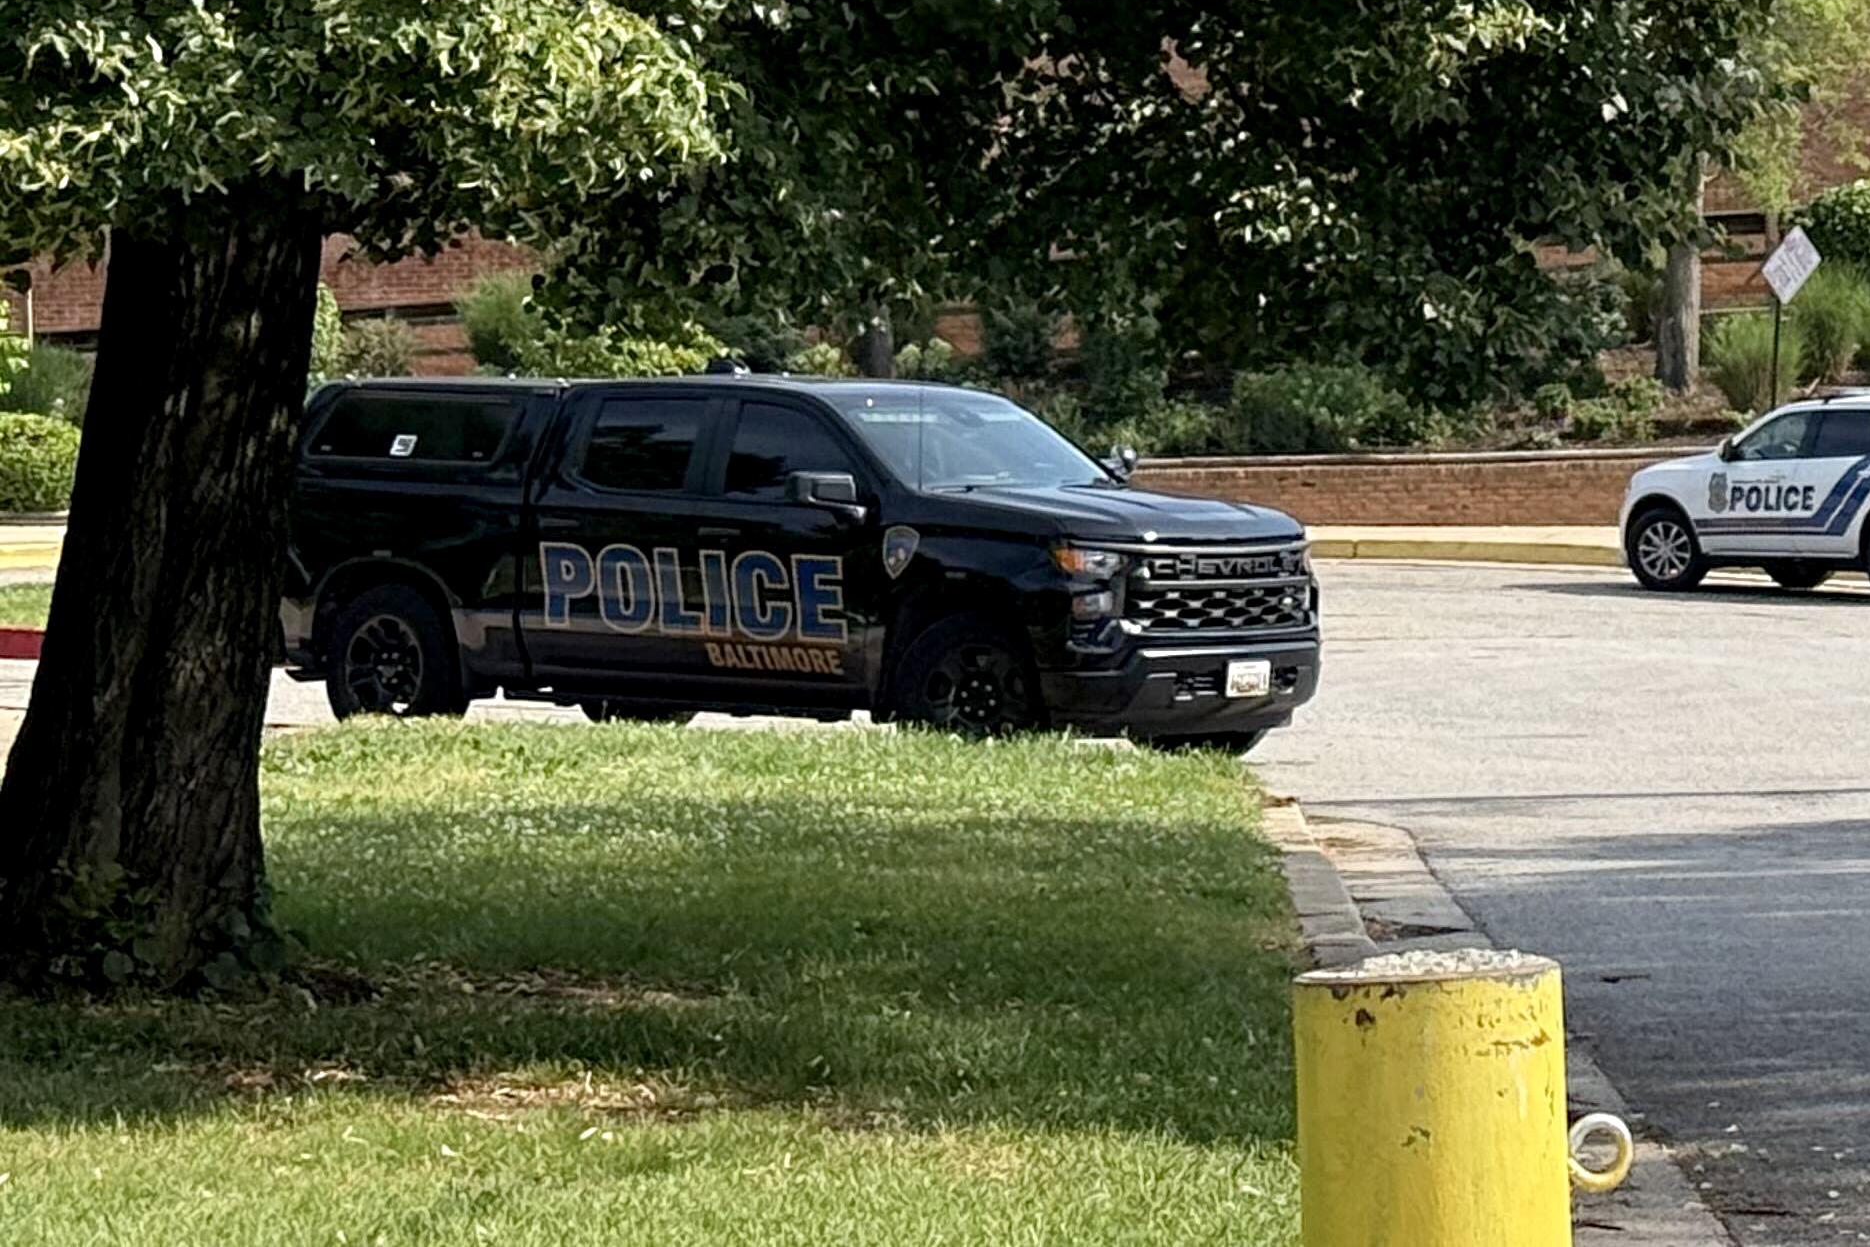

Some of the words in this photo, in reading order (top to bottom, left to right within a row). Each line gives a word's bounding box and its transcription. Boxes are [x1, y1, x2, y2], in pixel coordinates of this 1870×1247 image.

[1729, 485, 1815, 512] POLICE
[539, 541, 849, 644] POLICE
[705, 641, 844, 676] BALTIMORE
